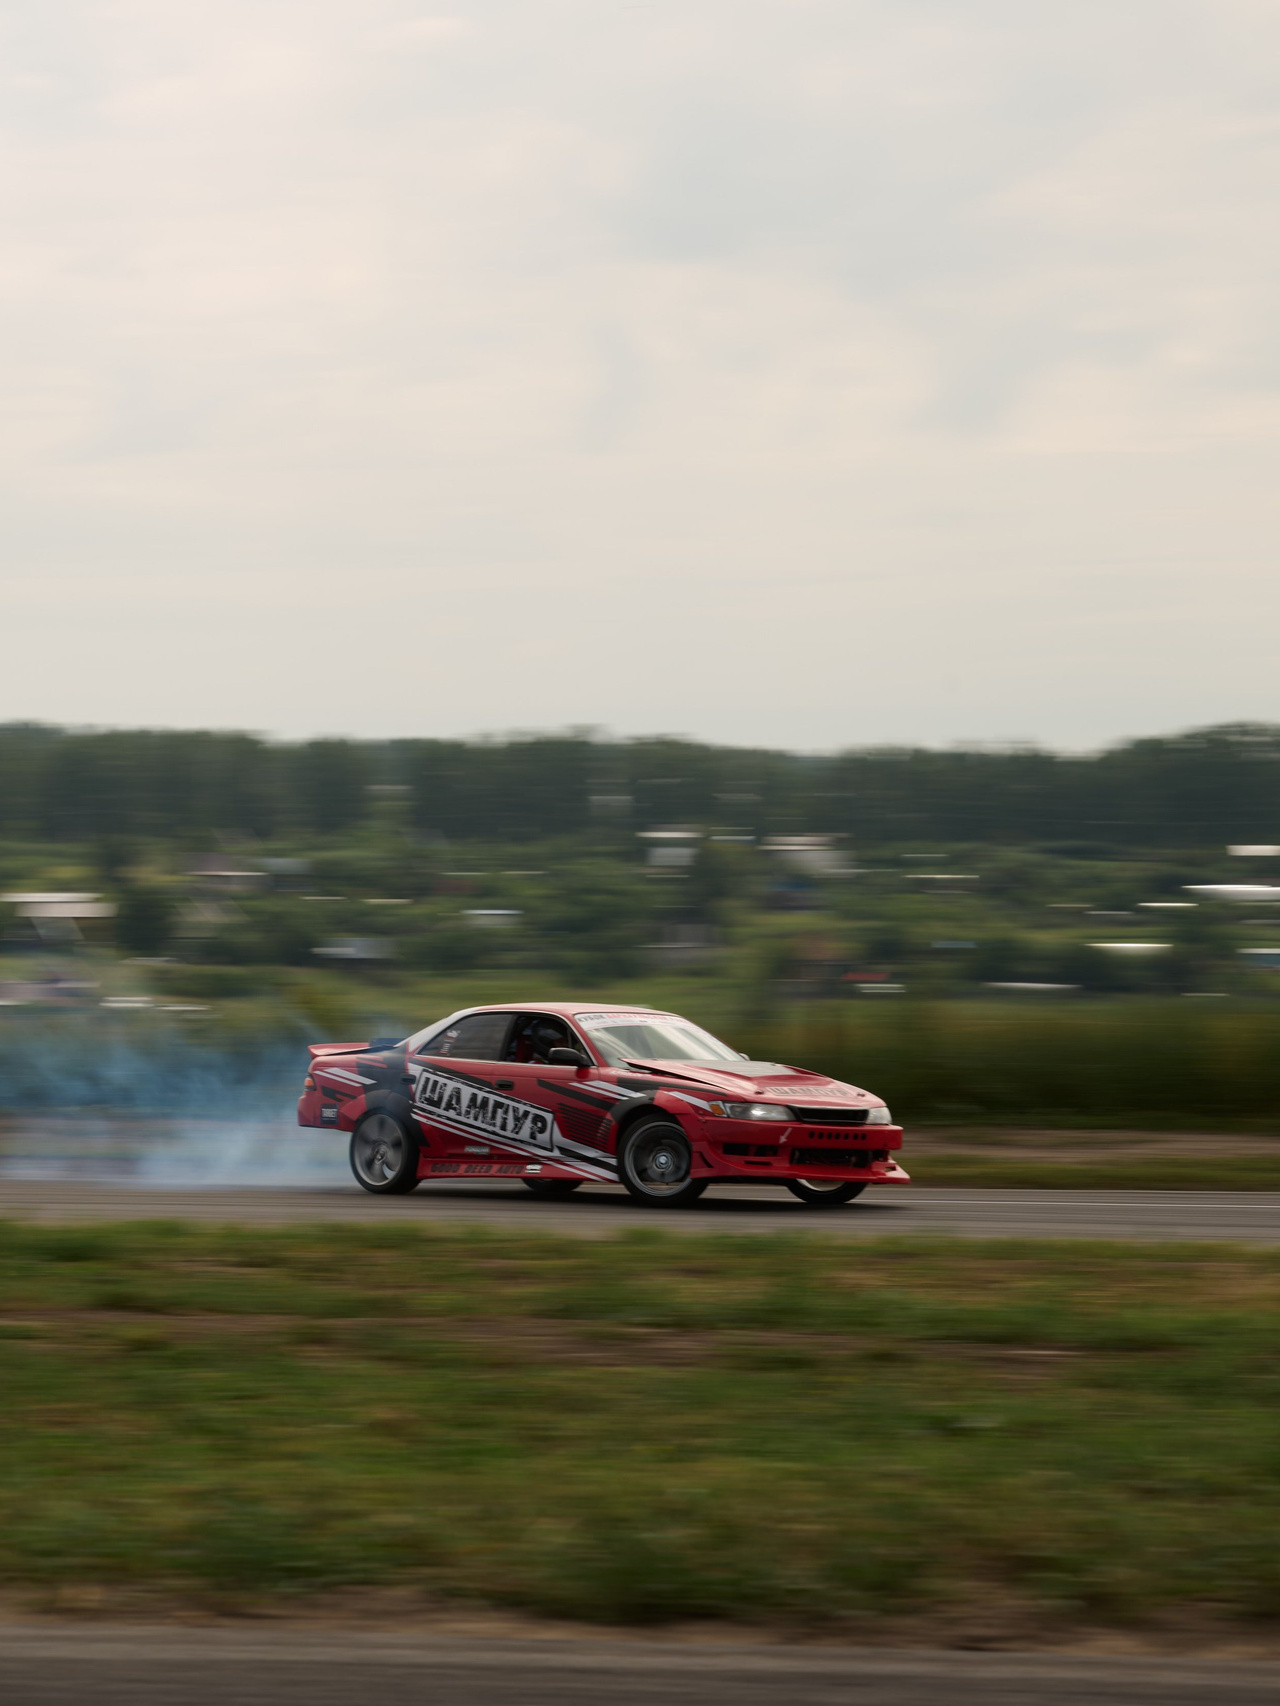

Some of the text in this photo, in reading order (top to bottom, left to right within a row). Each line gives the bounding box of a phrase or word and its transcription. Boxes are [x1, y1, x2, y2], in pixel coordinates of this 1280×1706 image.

[767, 1087, 851, 1098] ШАМПУР
[419, 1076, 548, 1141] ШАМПУР
[430, 1162, 525, 1175] GOOD DEED AUTO
